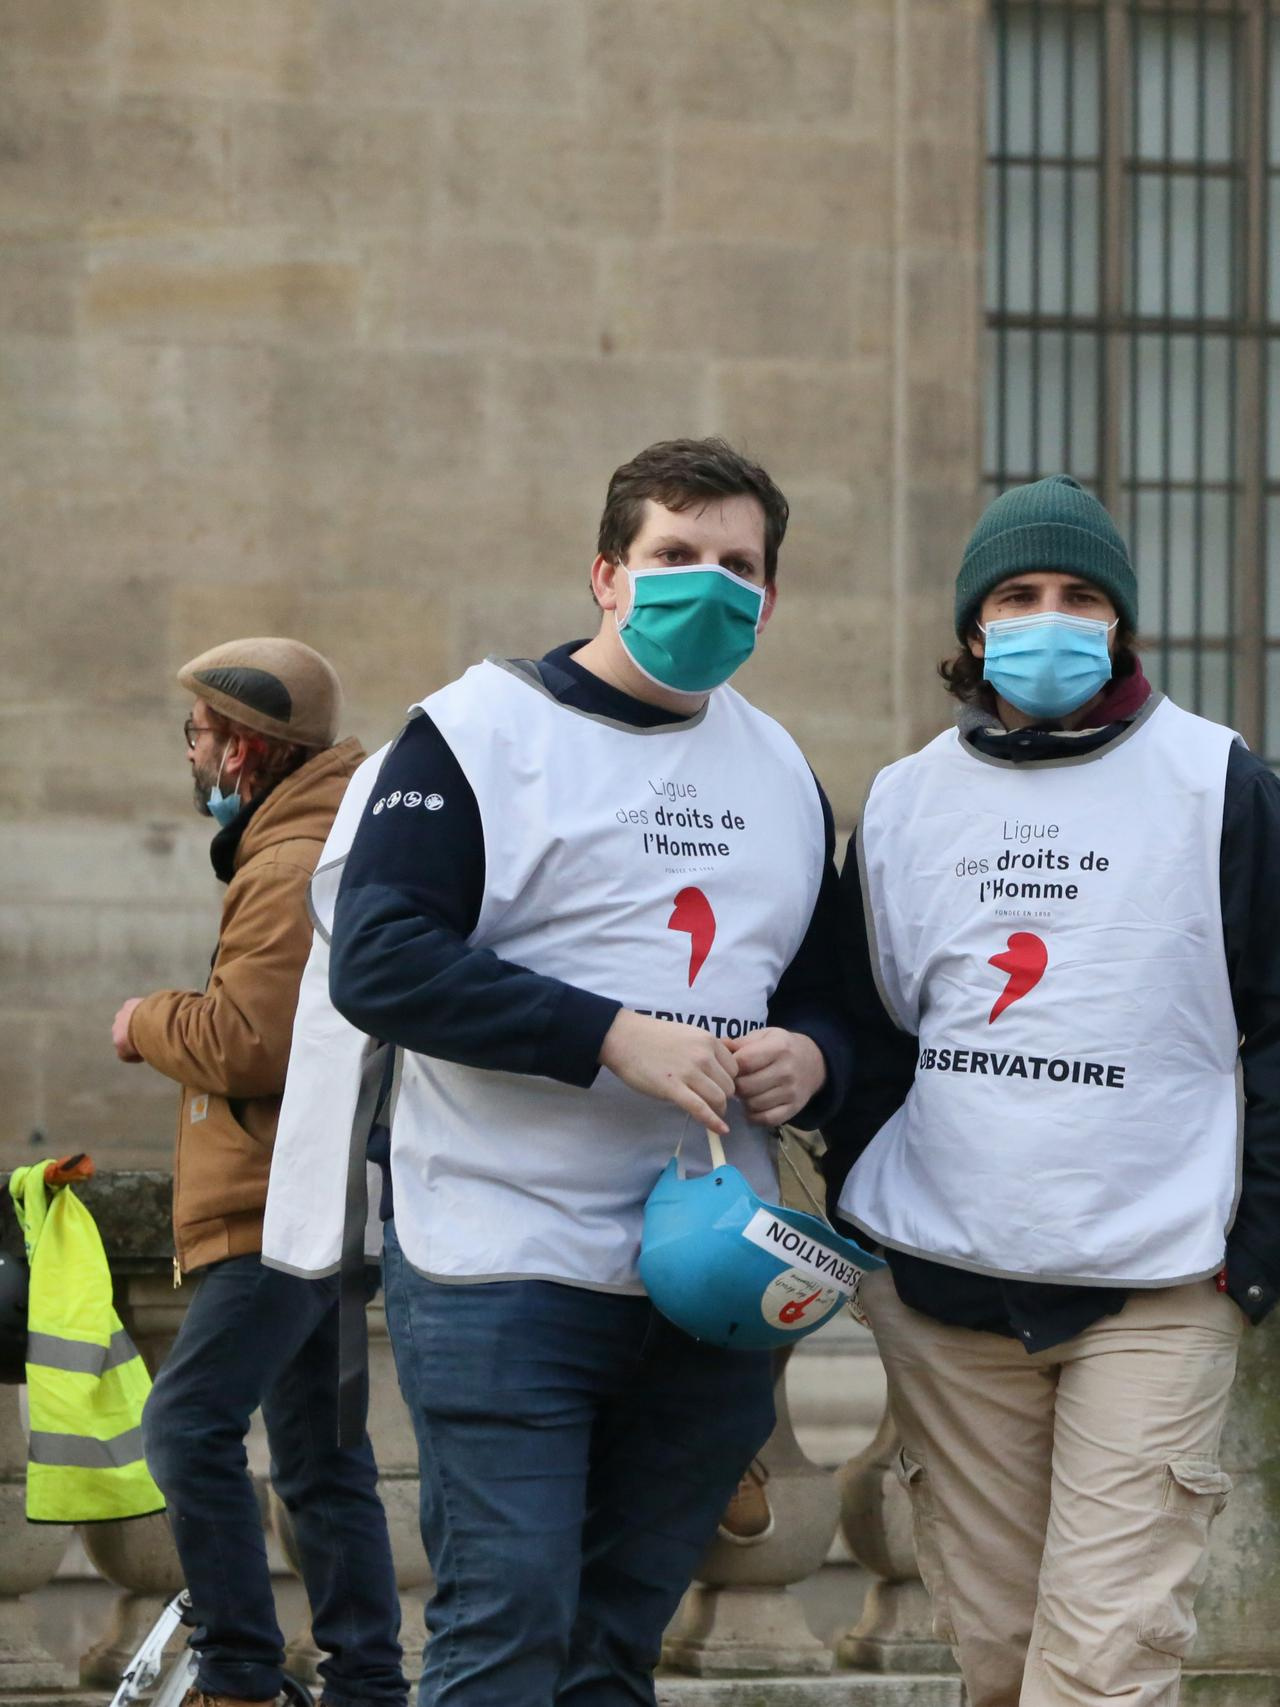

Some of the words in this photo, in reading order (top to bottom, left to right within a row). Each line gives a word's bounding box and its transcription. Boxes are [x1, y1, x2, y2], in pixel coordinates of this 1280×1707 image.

[648, 778, 697, 802] Ligue
[615, 808, 649, 825] des
[655, 806, 714, 829] droits
[721, 810, 745, 830] de
[643, 832, 730, 857] l'Homme
[1002, 820, 1060, 844] Ligue
[955, 857, 989, 877] des
[997, 848, 1070, 872] droits
[1079, 851, 1110, 872] de
[979, 877, 1079, 903] l'Homme
[920, 1048, 1126, 1089] OBSERVATOIRE
[766, 1221, 863, 1288] SERVATION
